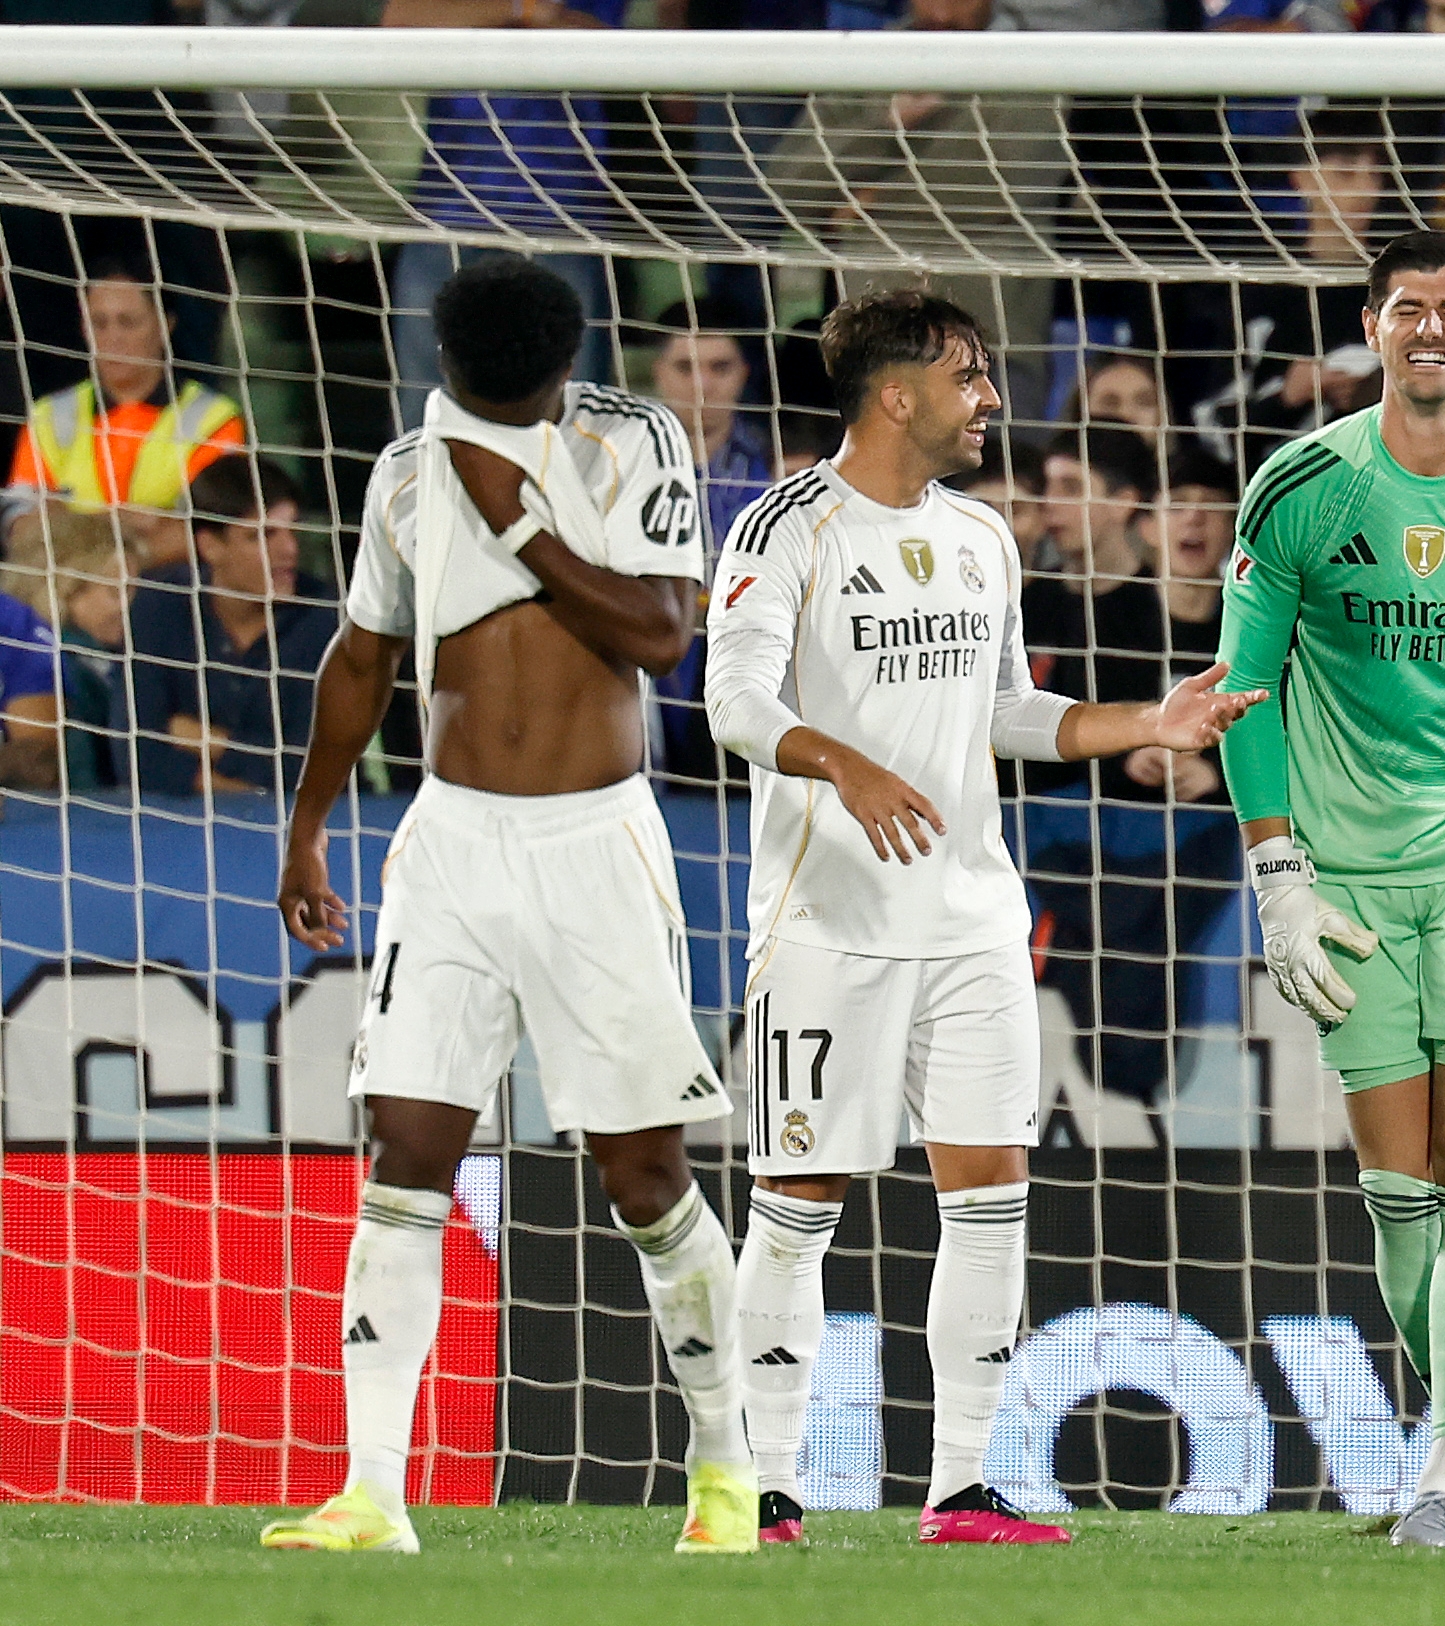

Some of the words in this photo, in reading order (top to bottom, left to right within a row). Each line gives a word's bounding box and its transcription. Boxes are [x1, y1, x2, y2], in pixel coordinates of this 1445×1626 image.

[644, 479, 694, 546] hp
[850, 607, 990, 652] Emirates
[1370, 632, 1401, 662] FLY
[876, 654, 909, 684] FLY
[918, 648, 976, 681] BETTER
[771, 1029, 832, 1101] 17
